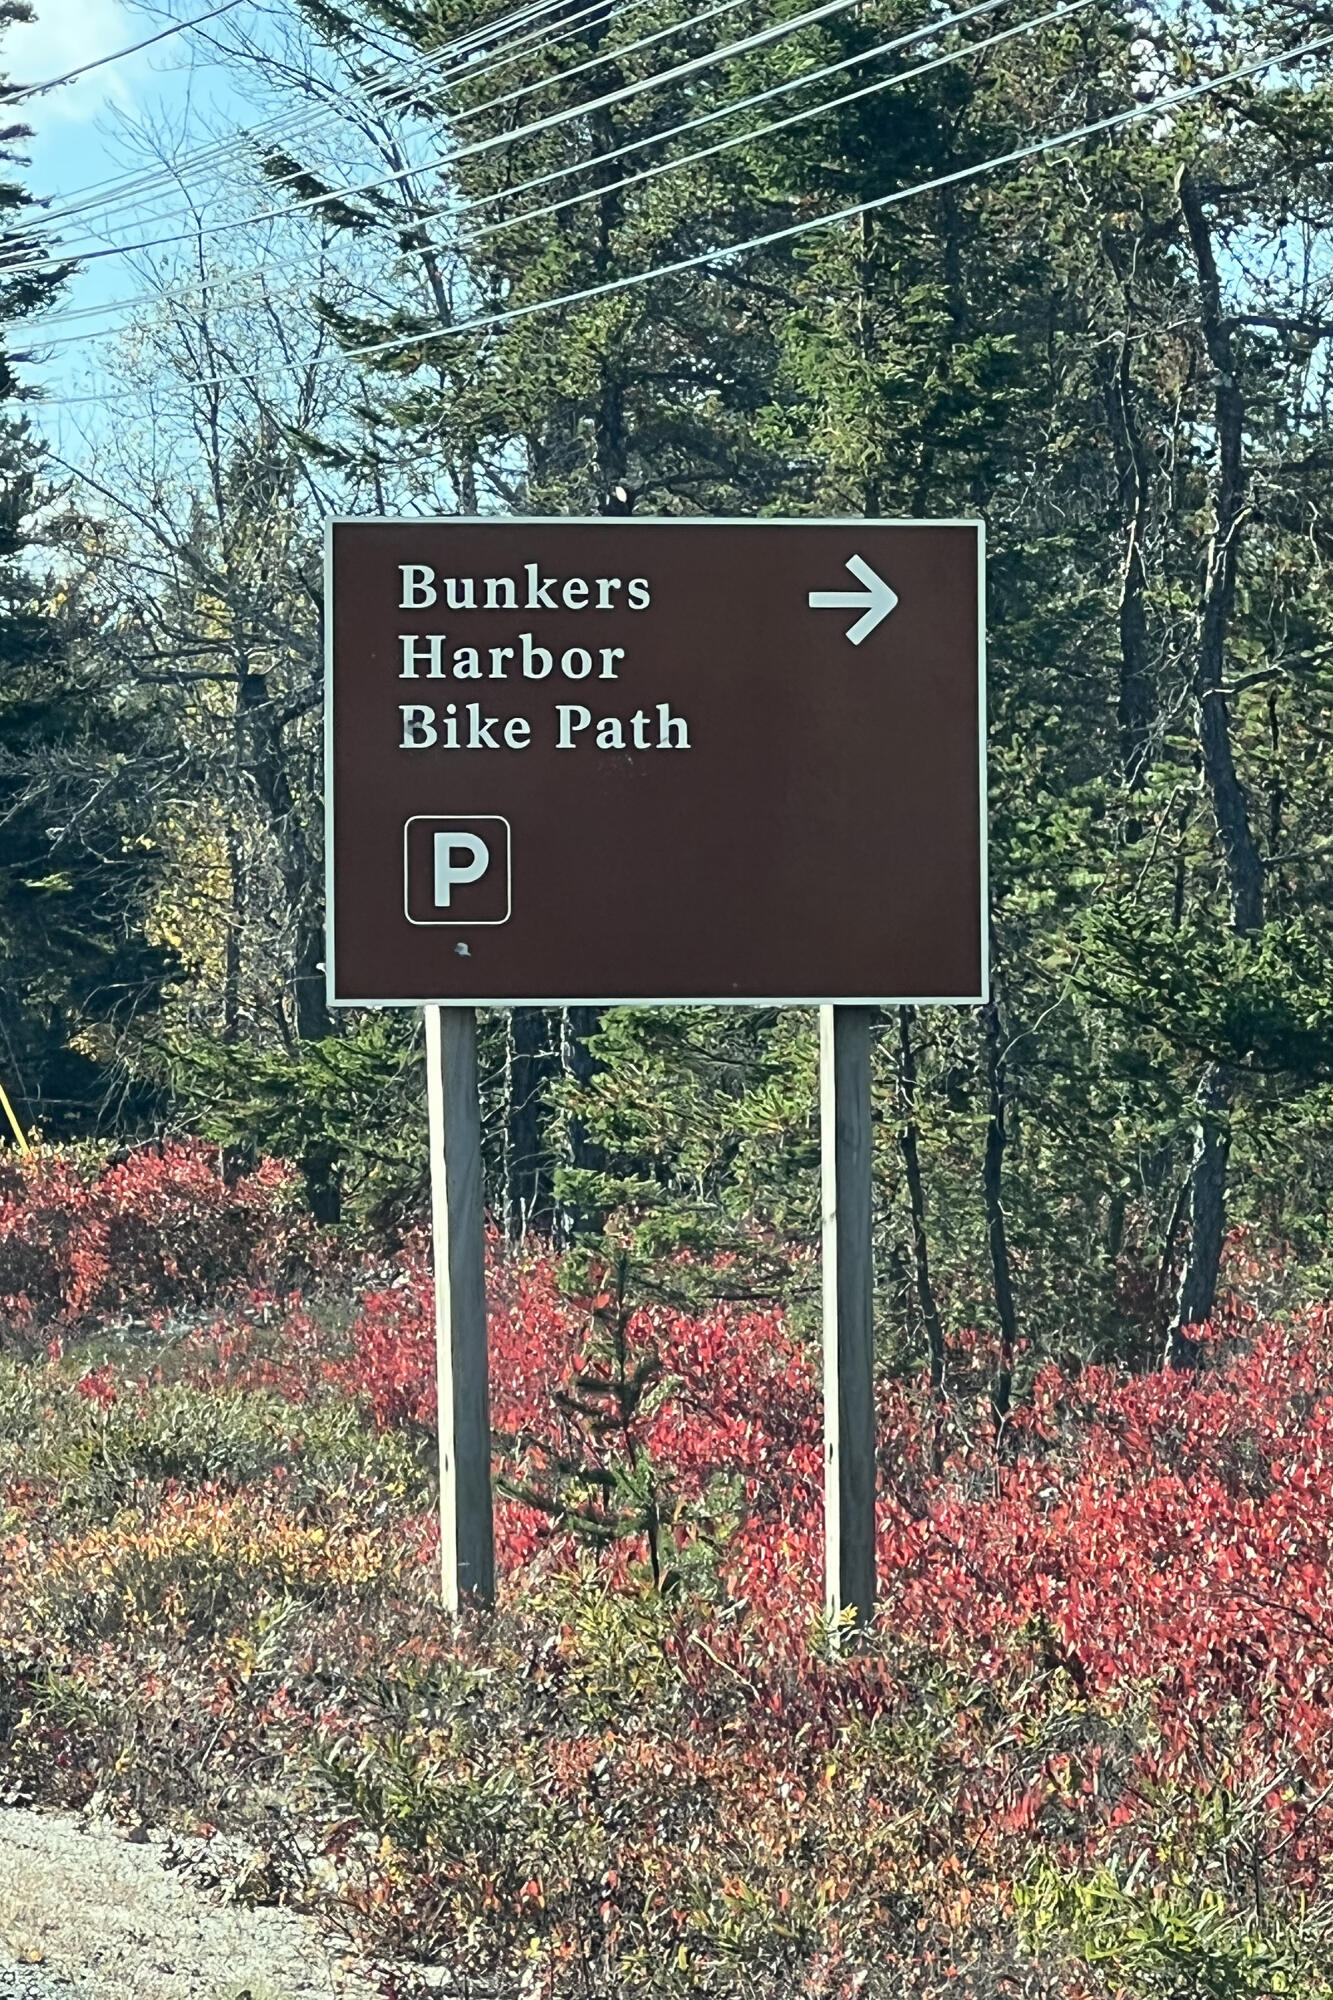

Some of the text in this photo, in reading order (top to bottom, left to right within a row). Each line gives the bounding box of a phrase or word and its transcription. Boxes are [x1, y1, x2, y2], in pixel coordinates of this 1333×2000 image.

[398, 563, 651, 610] Bunkers
[398, 632, 626, 679] Harbor
[398, 702, 692, 750] Bike Path
[433, 832, 490, 907] P
